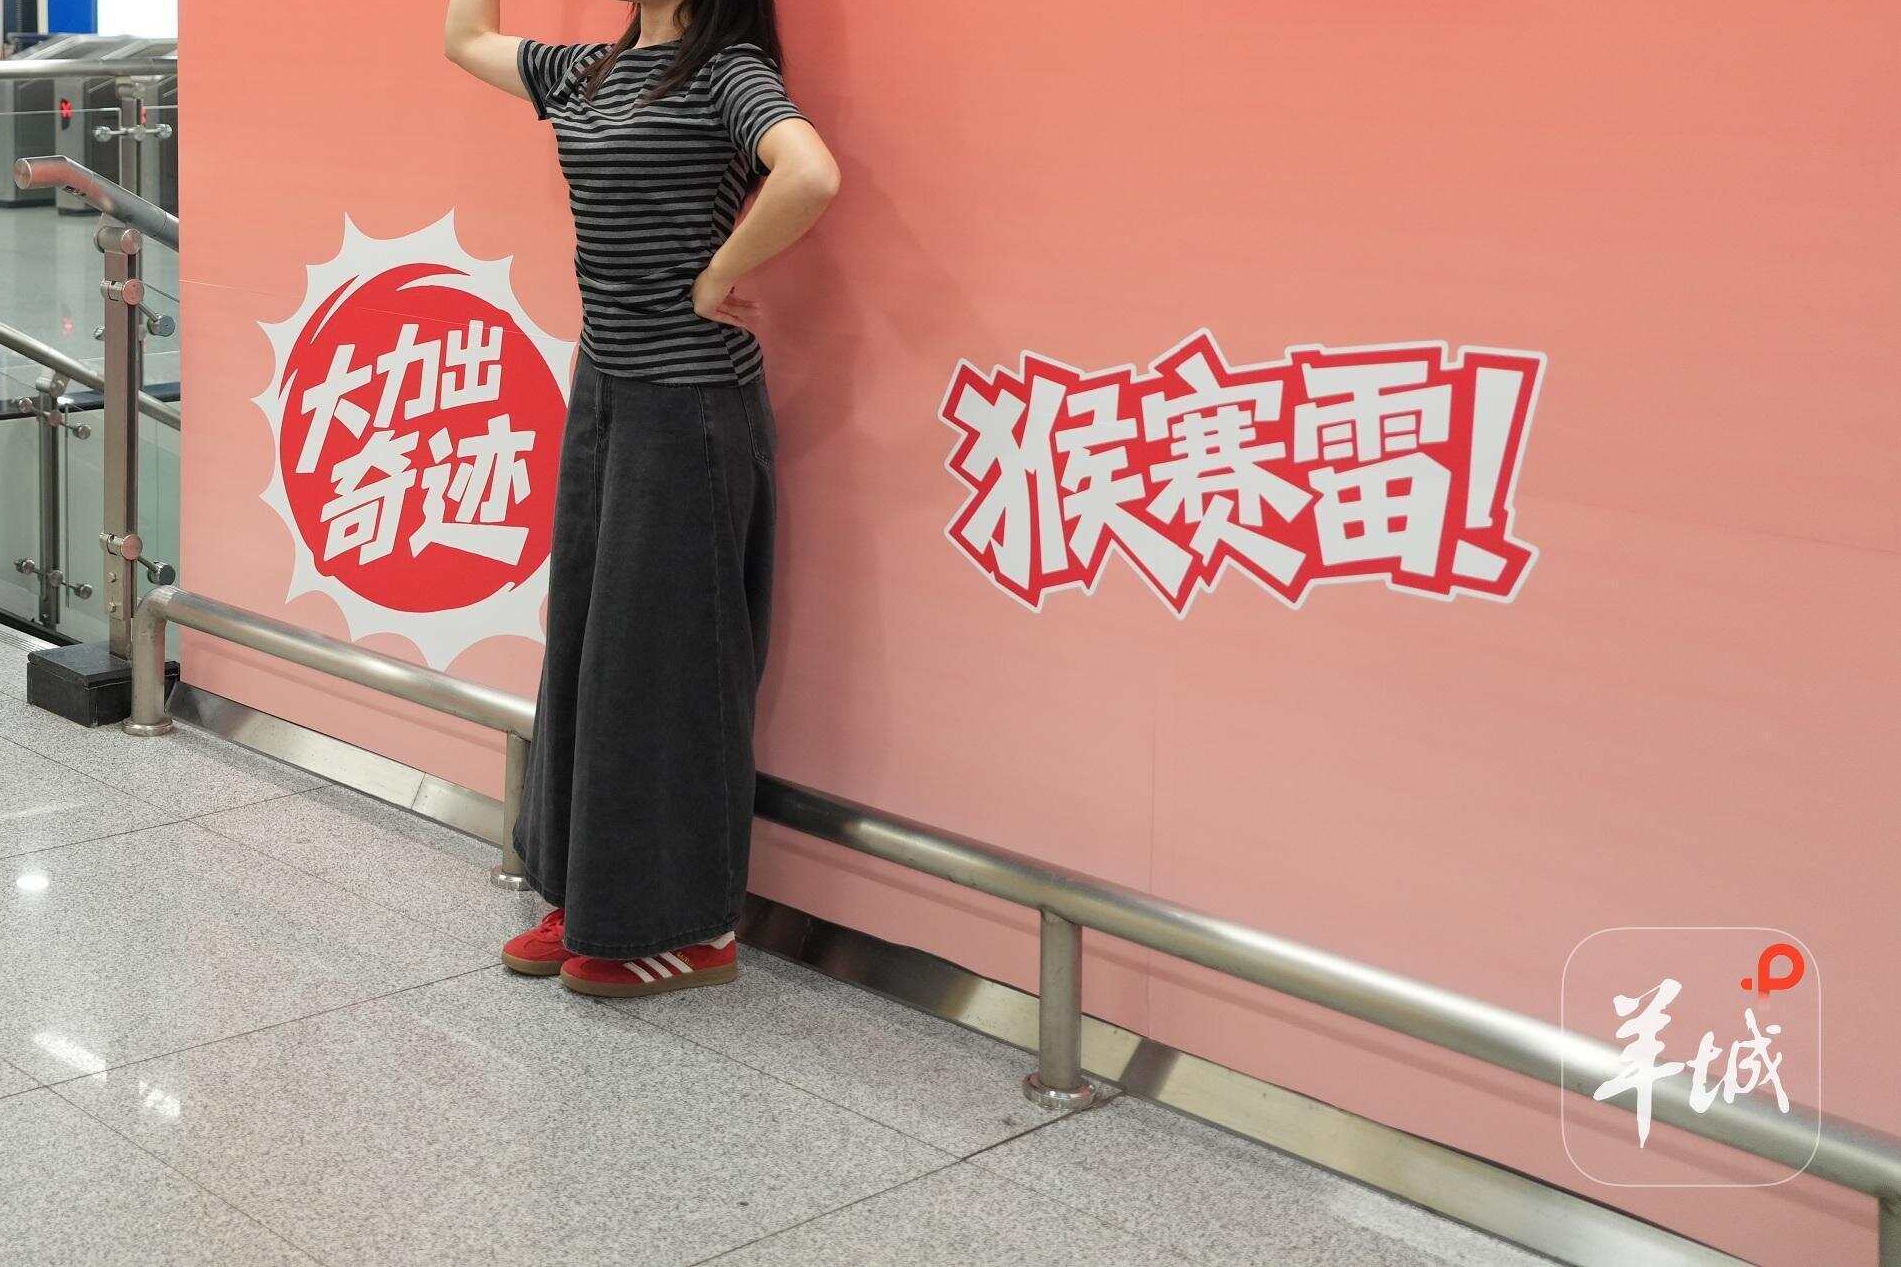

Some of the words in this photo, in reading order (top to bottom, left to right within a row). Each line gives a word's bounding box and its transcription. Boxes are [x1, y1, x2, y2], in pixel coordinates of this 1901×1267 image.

[295, 320, 504, 474] 大力出
[952, 349, 1525, 599] 猴赛雷!
[320, 413, 537, 567] 奇迹
